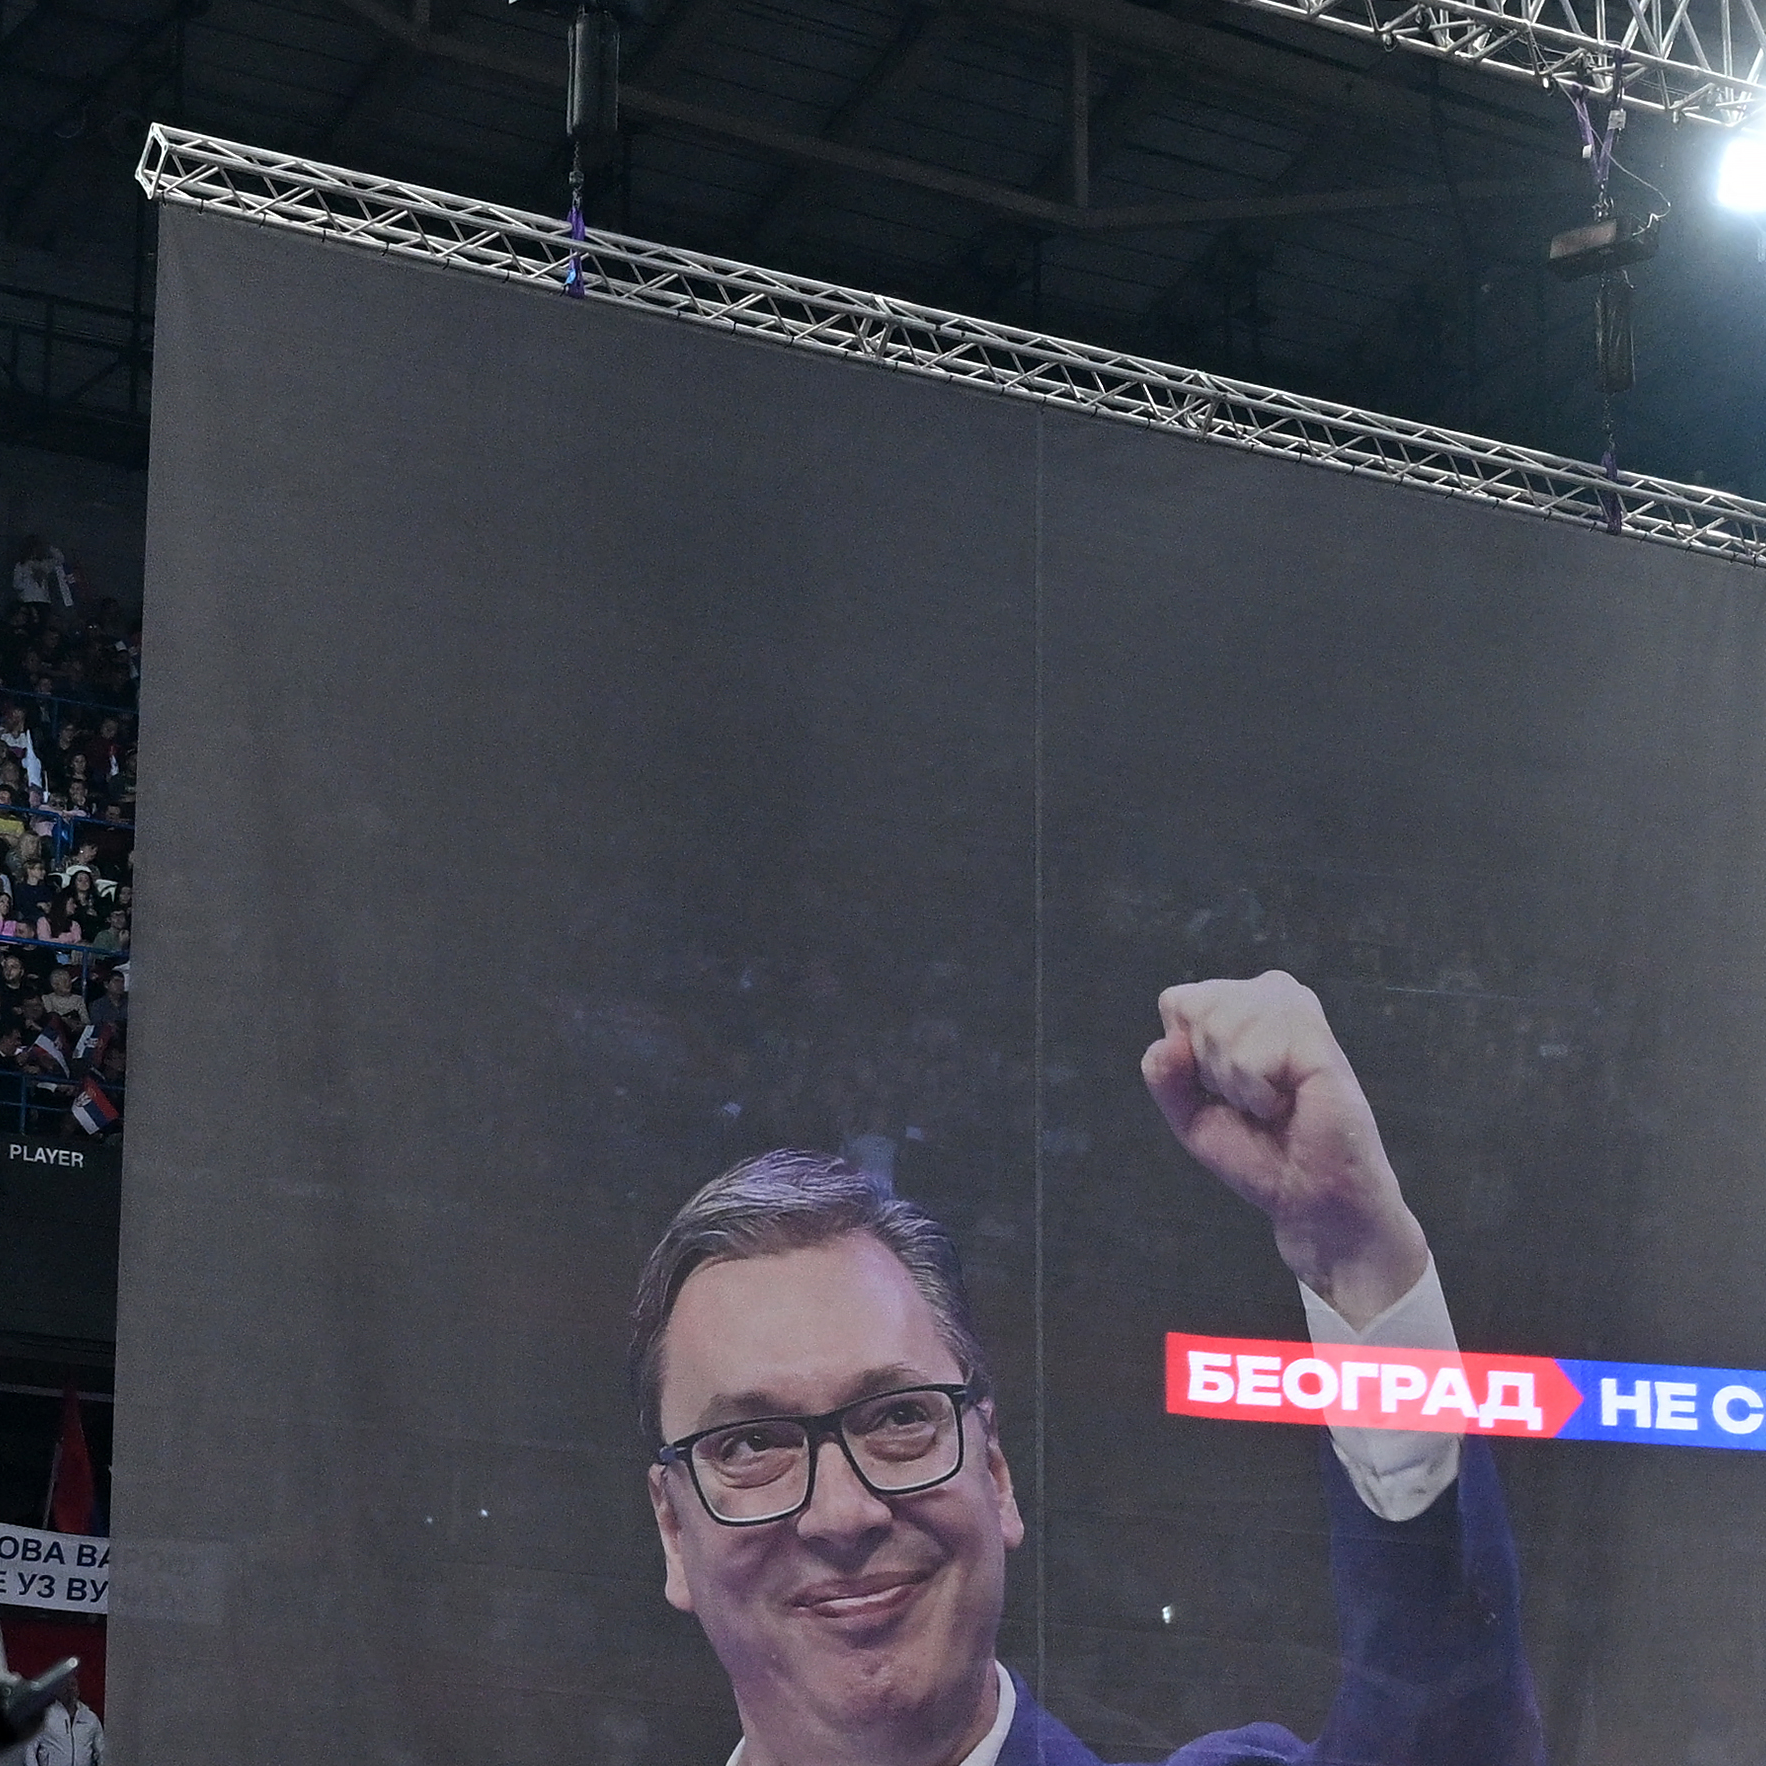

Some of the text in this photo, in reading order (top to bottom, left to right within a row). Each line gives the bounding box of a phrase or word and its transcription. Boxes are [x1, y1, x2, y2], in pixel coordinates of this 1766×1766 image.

[9, 1143, 84, 1168] PLAYER
[1187, 1350, 1545, 1433] БЕОГРАД
[1600, 1375, 1698, 1430] НЕ
[17, 1572, 55, 1599] УЗ
